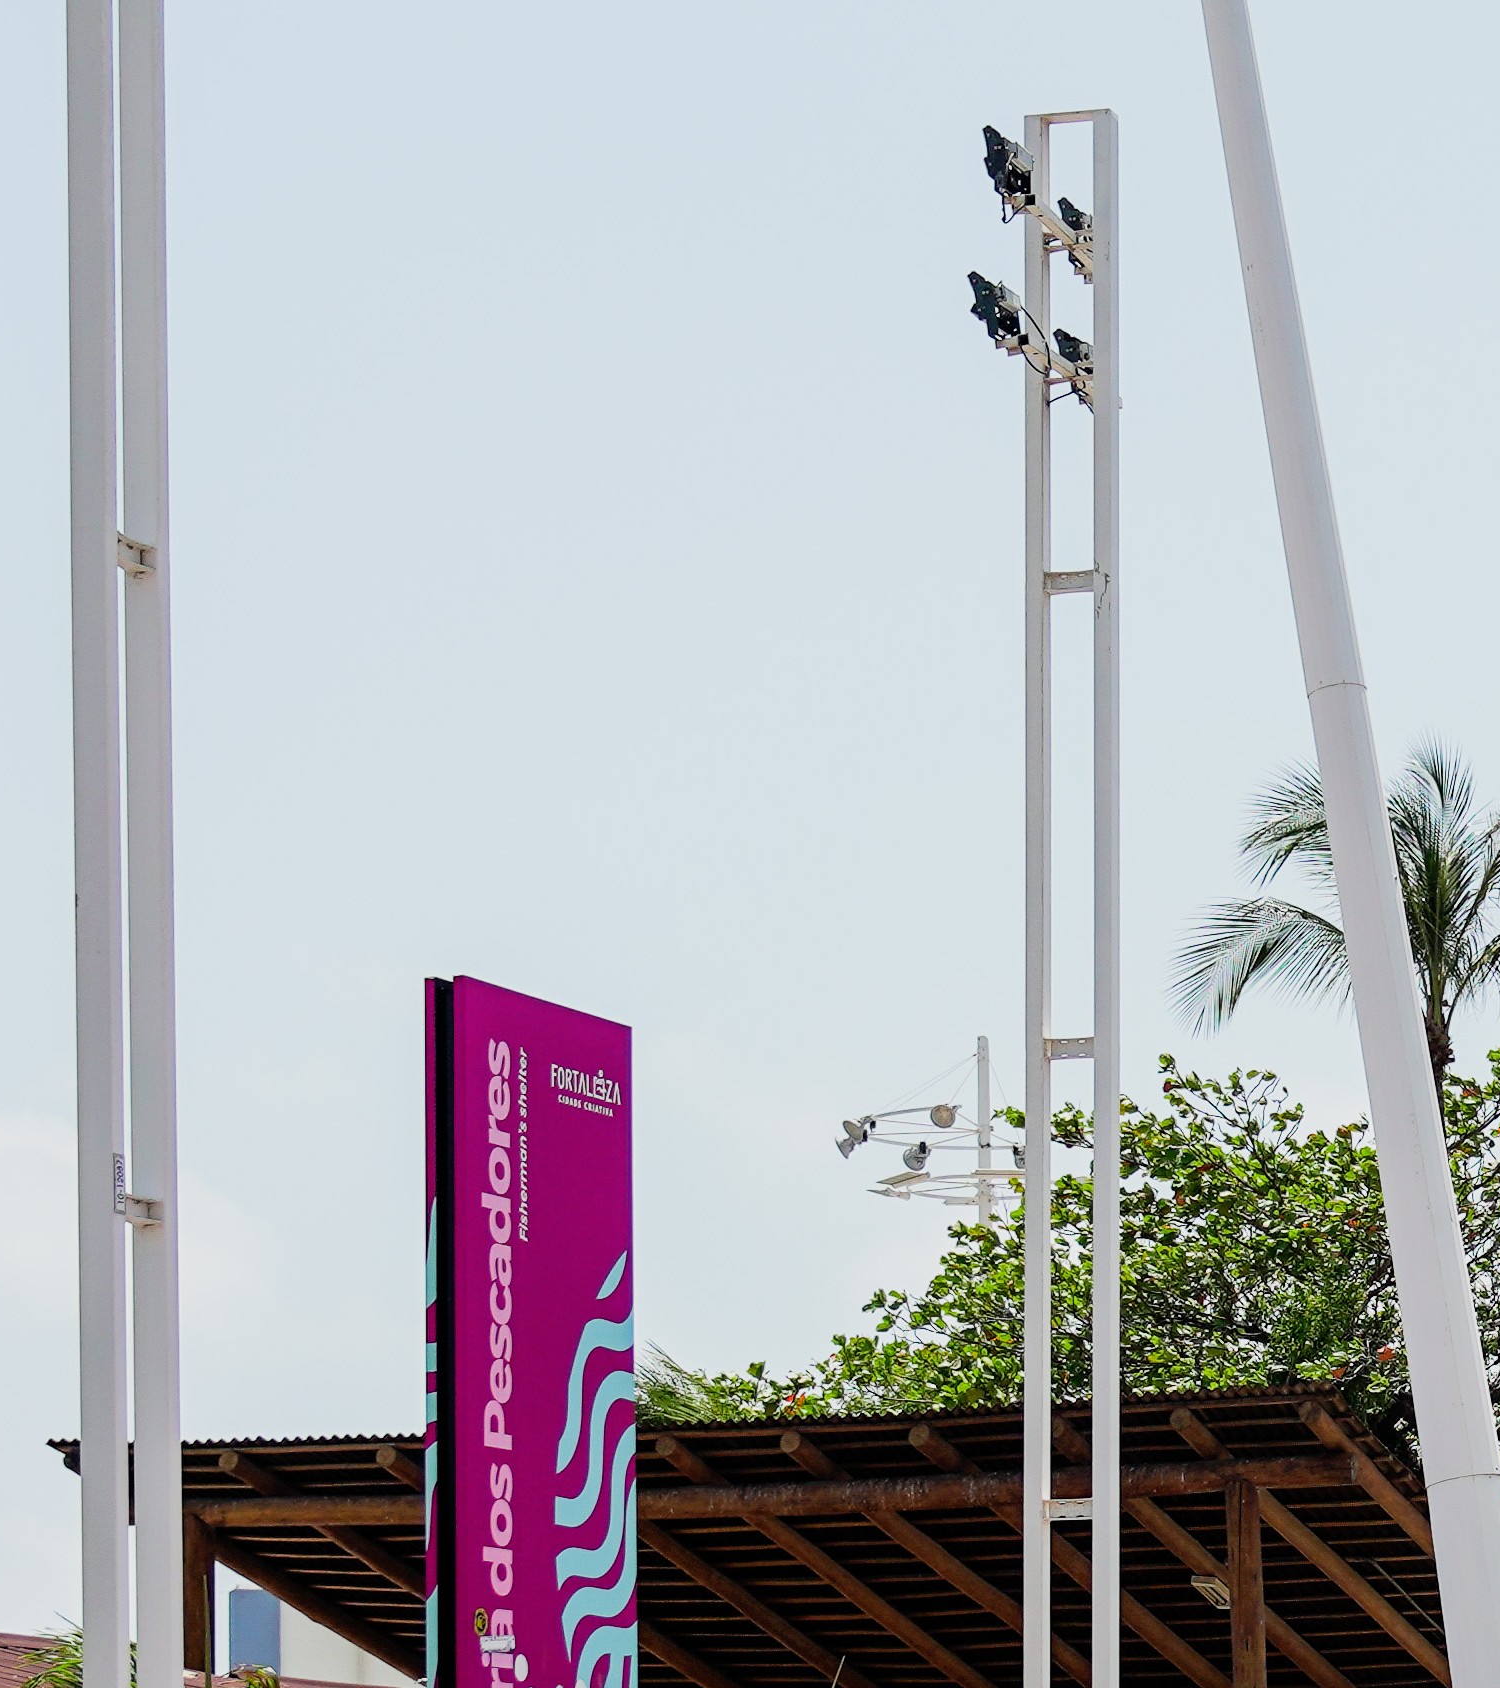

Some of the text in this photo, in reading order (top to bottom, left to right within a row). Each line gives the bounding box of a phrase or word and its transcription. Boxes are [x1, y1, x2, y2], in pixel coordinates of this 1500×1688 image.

[516, 1047, 530, 1243] Fisherman's shelter
[551, 1063, 622, 1106] FORTALEZA
[558, 1094, 614, 1118] CIDADE CRIATIVA
[481, 1037, 514, 1451] Pescadores
[482, 1463, 514, 1596] dos
